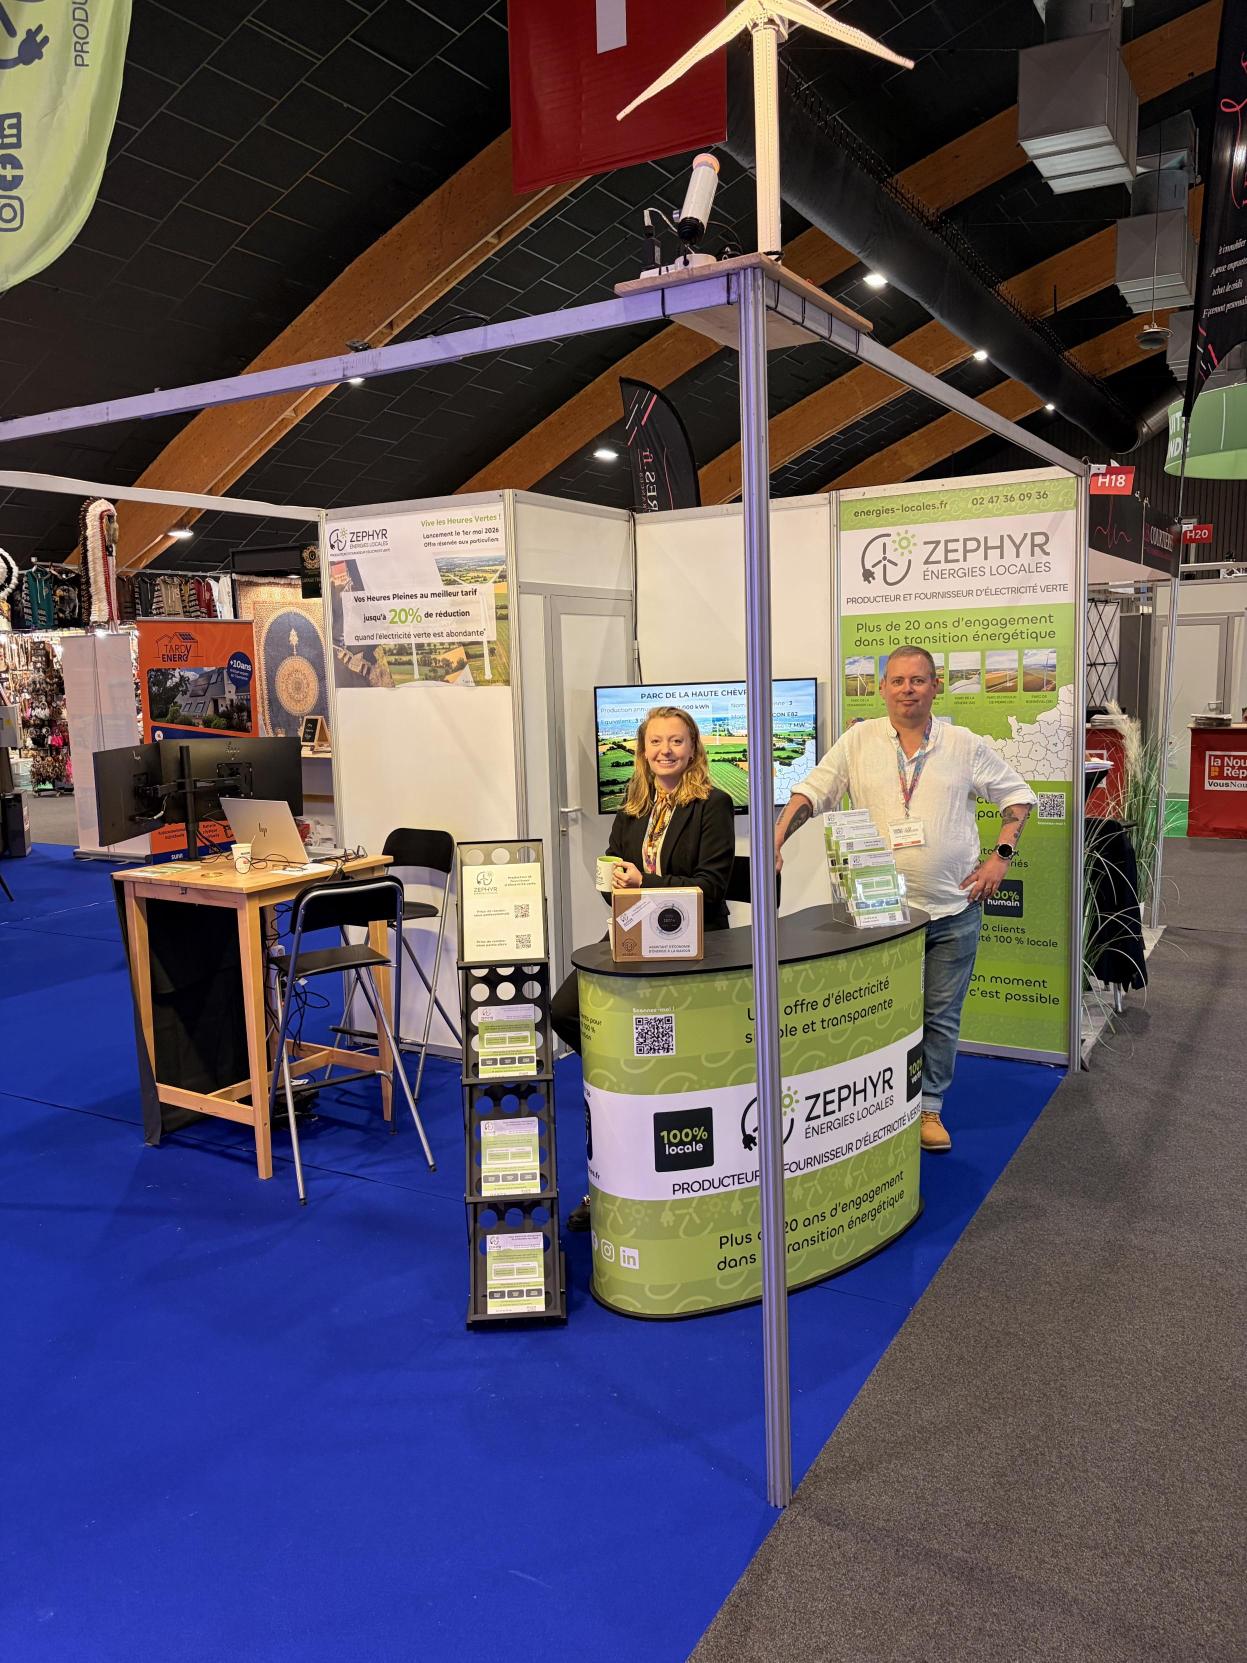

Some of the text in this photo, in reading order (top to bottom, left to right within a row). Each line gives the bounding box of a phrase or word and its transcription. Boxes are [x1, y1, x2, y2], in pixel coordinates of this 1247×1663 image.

[1098, 474, 1126, 488] H18
[854, 491, 1048, 518] energies-locales.fr 02 47 36 09 36
[350, 529, 388, 542] ZEPHYR
[470, 537, 499, 546] particuliers
[1186, 530, 1208, 540] H20
[923, 532, 1050, 566] ZEPHYR
[923, 562, 1052, 581] ÉNERGIES LOCALES
[392, 592, 418, 600] Pleines
[431, 590, 459, 598] meilleur
[460, 588, 478, 596] tarif
[846, 583, 1068, 605] PRODUCTEUR ET FOURNISSEUR D'ÉLECTRICITÉ VERTE
[364, 614, 386, 623] jusqu'à
[389, 608, 422, 625] 20%
[435, 610, 470, 618] réduction
[856, 613, 1054, 632] Plus de 20 ans d'engagement
[355, 633, 374, 642] quand
[376, 632, 412, 640] l'électricité
[854, 628, 1056, 647] dans la transition énergétique
[1211, 756, 1247, 766] la Nou
[1224, 767, 1247, 779] Rép
[1011, 859, 1028, 868] riés
[987, 898, 1020, 907] humain
[993, 891, 1019, 900] 00%
[992, 925, 1026, 934] clients
[995, 935, 1012, 944] 100
[1015, 937, 1024, 945] %
[1027, 937, 1058, 948] locale
[990, 975, 1048, 988] moment
[784, 1000, 818, 1016] offre
[823, 976, 889, 1008] d'électricité
[969, 987, 1060, 1005] c'est possible
[802, 1021, 816, 1033] et
[821, 998, 893, 1030] transparente
[805, 1067, 893, 1122] ZEPHYR
[805, 1095, 894, 1139] ÉNERGIES LOCALES
[660, 1127, 708, 1144] 100%
[856, 1111, 907, 1150] D'ÉLECTRICITÉ
[665, 1142, 703, 1155] locale
[720, 1232, 752, 1250] Plus
[803, 1211, 826, 1228] ans
[830, 1171, 904, 1218] d'engagement
[717, 1190, 905, 1271] dans ransition énergétique
